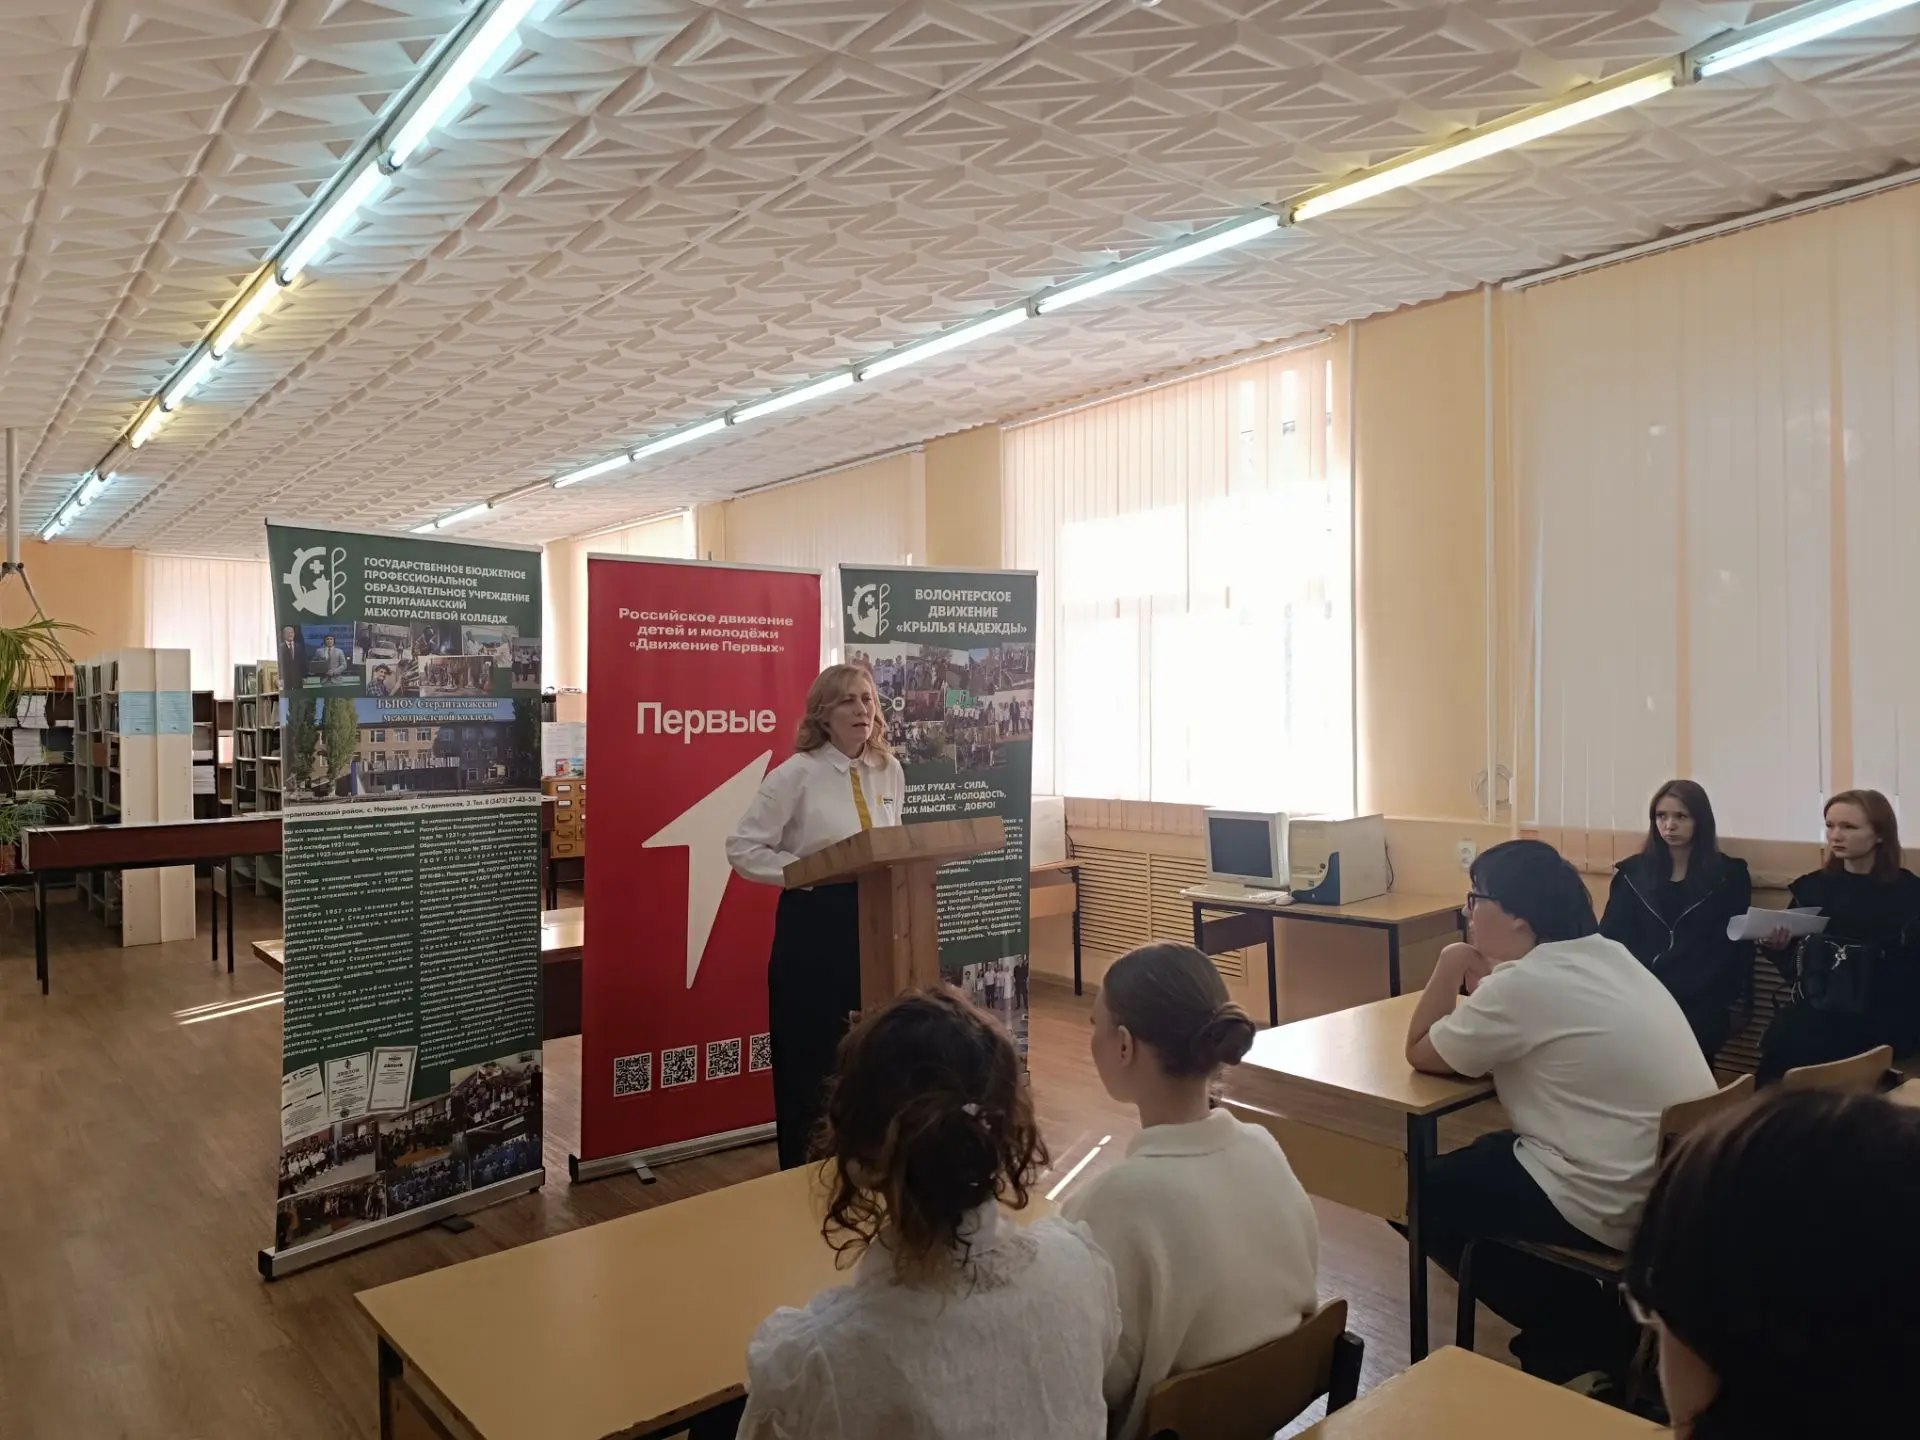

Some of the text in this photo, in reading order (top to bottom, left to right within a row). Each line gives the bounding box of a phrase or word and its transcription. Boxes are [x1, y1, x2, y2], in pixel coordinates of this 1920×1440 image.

[364, 558, 526, 579] ГОСУДАРСТВЕННОЕ БЮДЖЕТНОЕ
[364, 570, 478, 587] ПРОФЕССИОНАЛЬНОЕ
[364, 583, 530, 602] ОБРАЗОВАТЕЛЬНОЕ УЧРЕЖДЕНИЕ
[915, 589, 1012, 602] ВОЛОНТЕРСКОЕ
[364, 595, 467, 609] СТЕРЛИТАМАКСКИЙ
[364, 608, 508, 624] МЕЖОТРАСЛЕВОЙ КОЛЛЕДЖ
[619, 607, 794, 626] Российское движение
[928, 606, 999, 618] ДВИЖЕНИЕ
[637, 625, 779, 639] детей и молодёжи
[896, 621, 1027, 635] «КРЫЛЬЯ НАДЕЖДЫ»
[629, 638, 785, 654] «Движение Первых»
[637, 701, 777, 744] Первые
[904, 784, 925, 792] ШИХ
[928, 783, 956, 791] РУКАХ
[964, 781, 988, 789] СИЛА,
[907, 793, 946, 803] СЕРДЦАХ
[954, 791, 1007, 800] МОЛОДОСТЬ,
[285, 809, 340, 819] рлитамакский
[920, 803, 956, 813] МЫСЛЯХ
[964, 802, 996, 811] ДОБРО!
